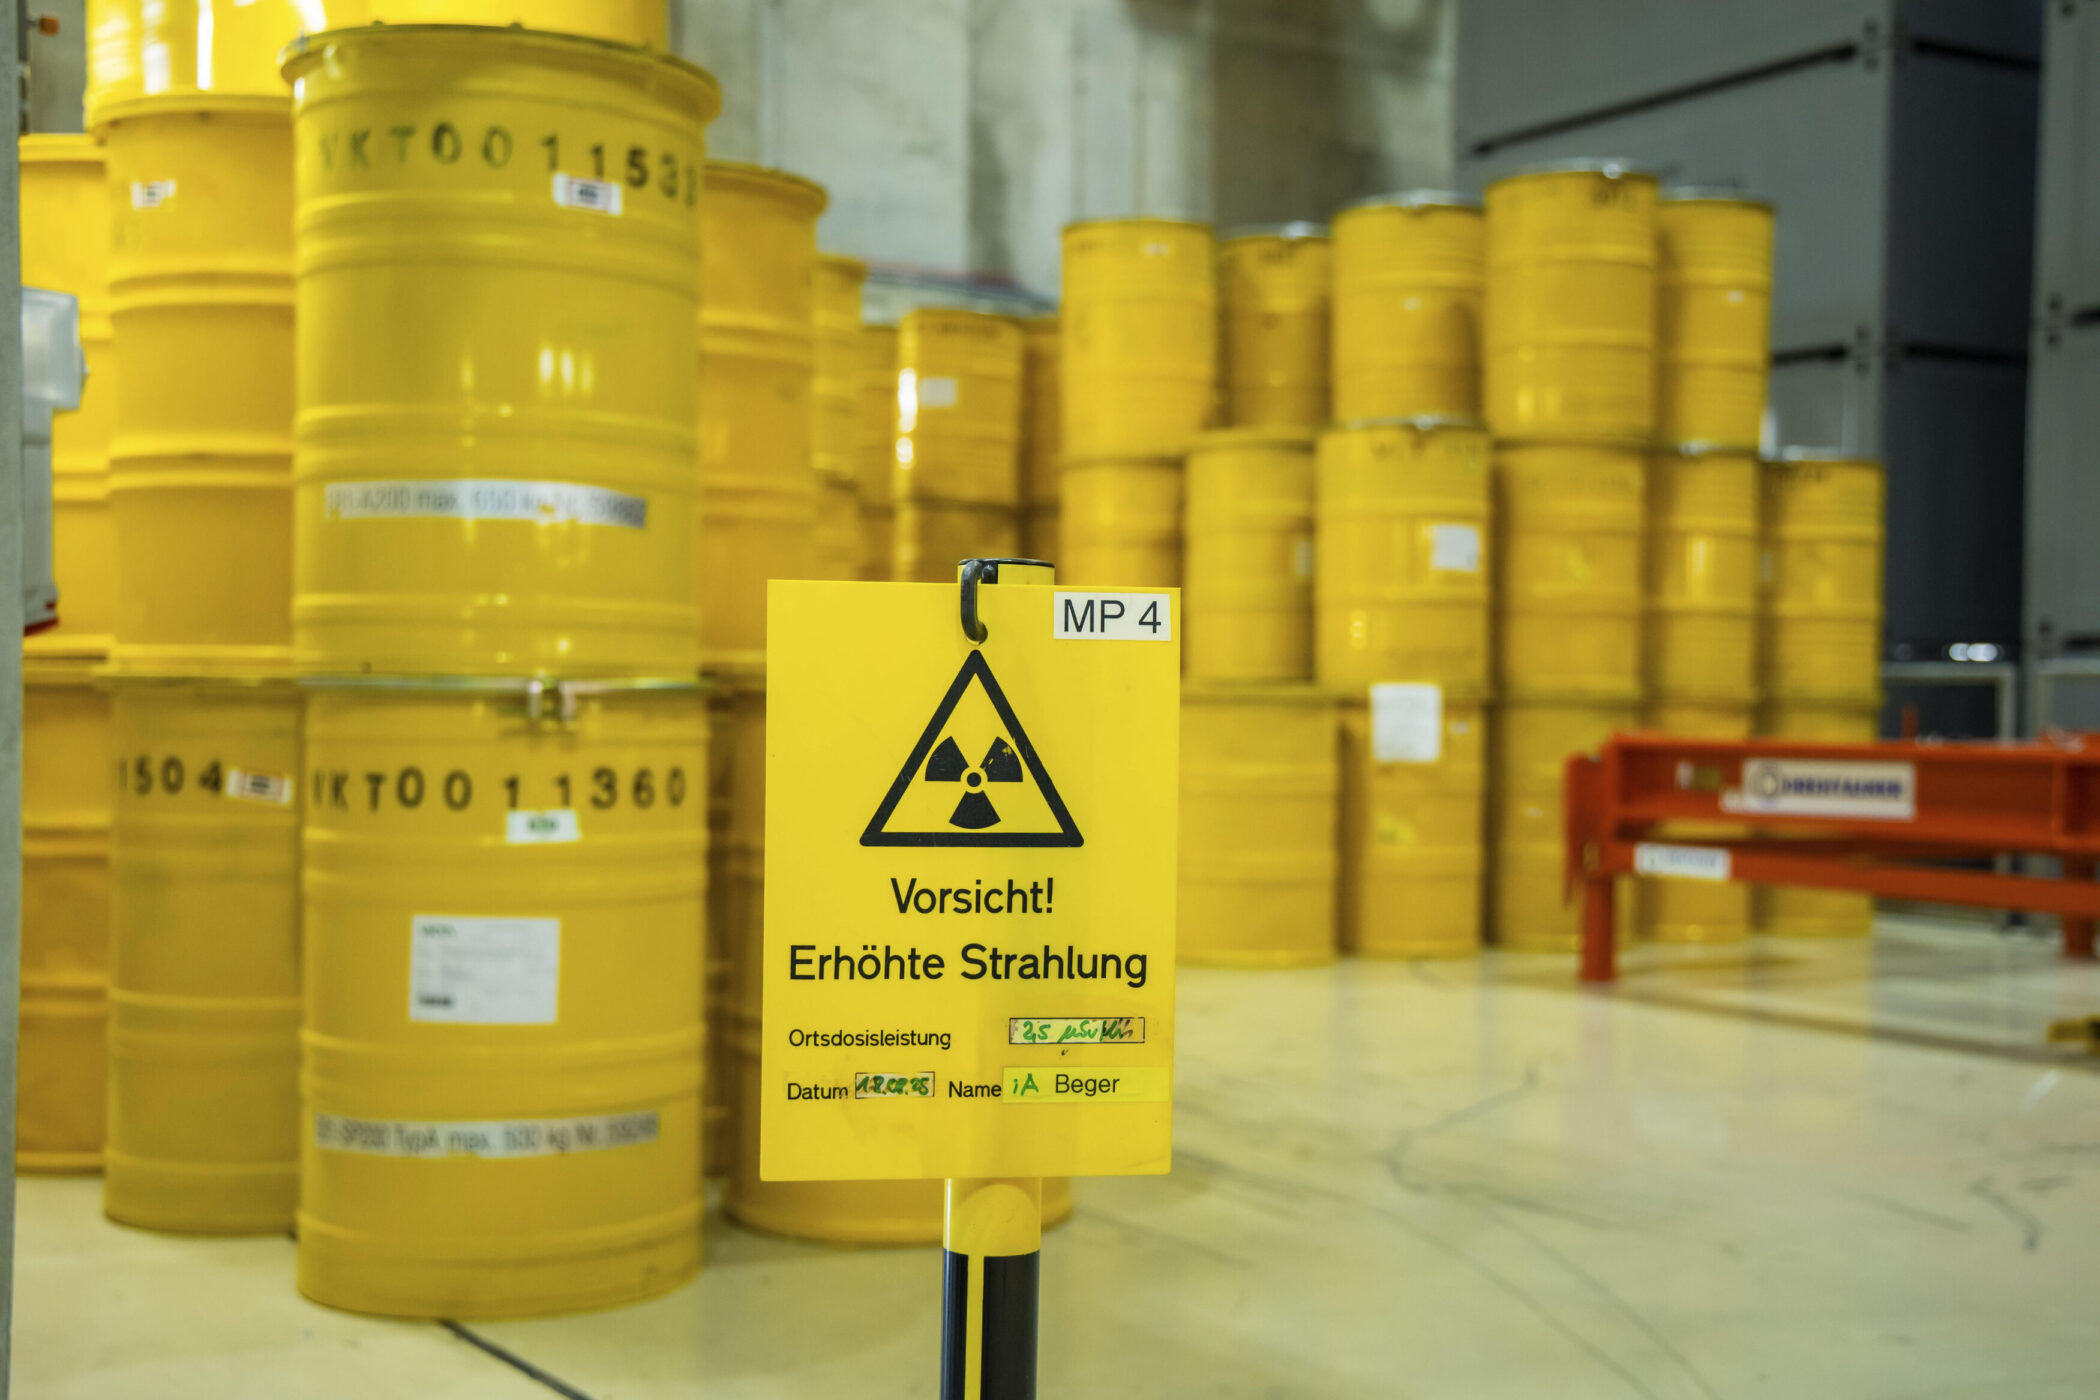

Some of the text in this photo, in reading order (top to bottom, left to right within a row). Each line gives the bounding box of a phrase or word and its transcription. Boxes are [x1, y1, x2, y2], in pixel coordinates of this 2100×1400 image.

[1064, 598, 1162, 634] MP 4
[890, 877, 1054, 914] Vorsicht!
[789, 943, 1148, 989] Erhöhte Strahlung
[788, 1028, 952, 1051] Ortsdosisleistung
[787, 1082, 849, 1101] Datum
[948, 1080, 1002, 1099] Name
[1054, 1073, 1120, 1097] Beger
